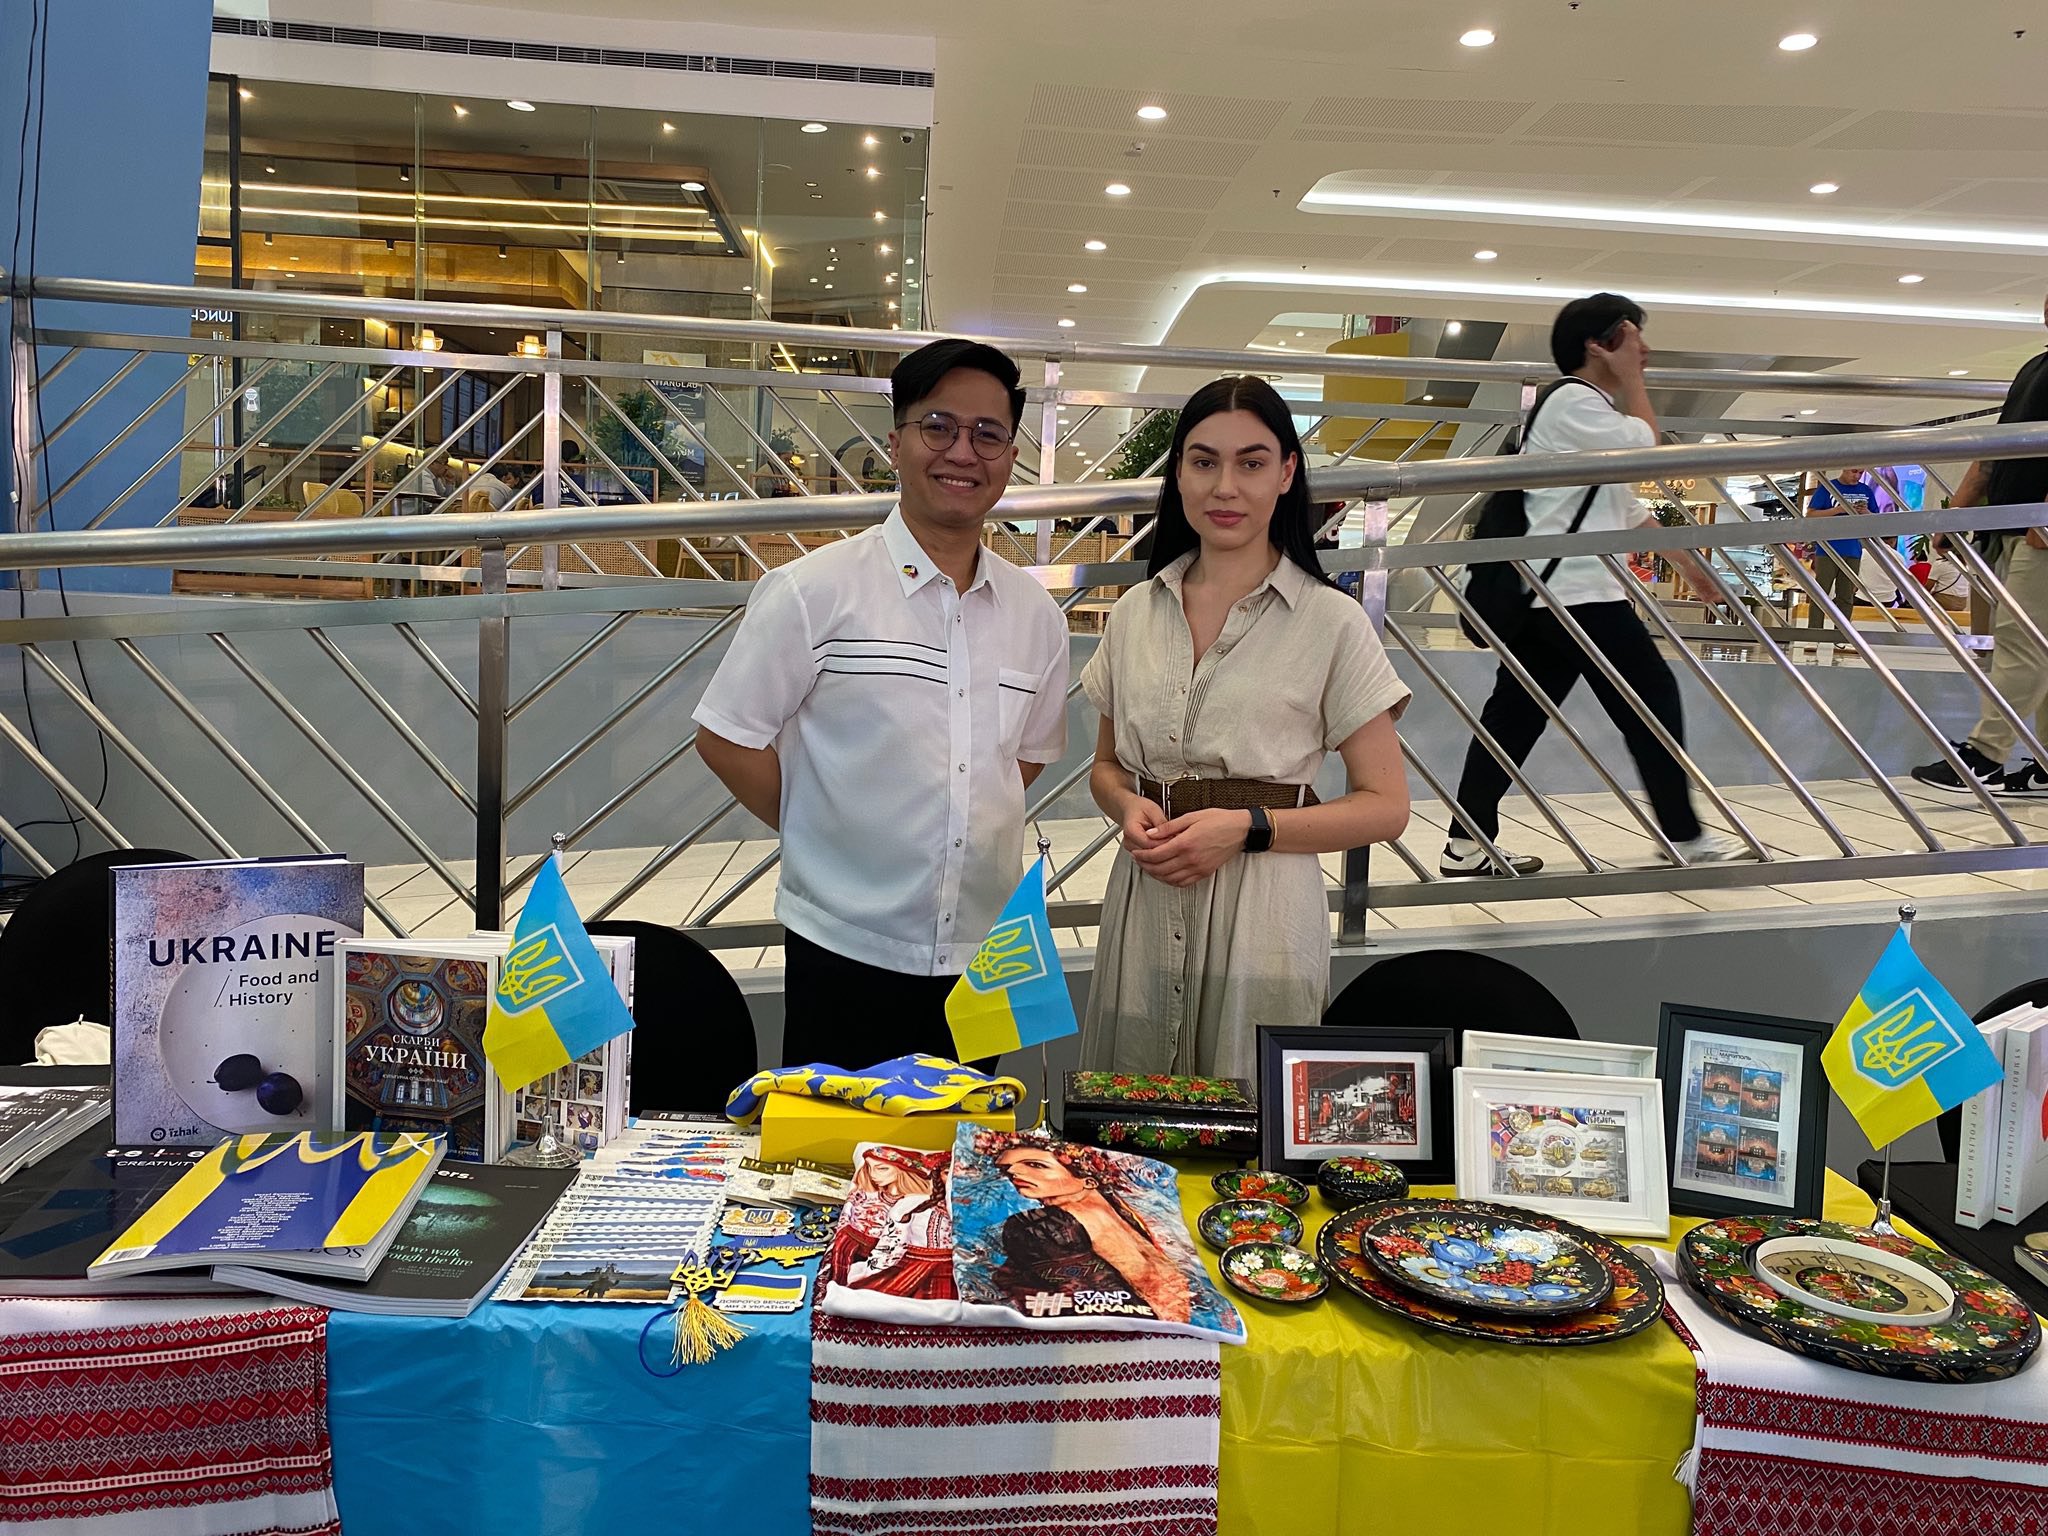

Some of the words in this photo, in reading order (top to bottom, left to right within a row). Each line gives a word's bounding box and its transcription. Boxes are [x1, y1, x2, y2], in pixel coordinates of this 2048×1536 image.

[149, 930, 335, 967] UKRAINE
[239, 972, 282, 987] Food
[287, 970, 319, 984] and
[229, 992, 293, 1007] History
[392, 1034, 440, 1047] СКАРБИ
[364, 1045, 467, 1070] УКРАЇНИ
[1967, 1123, 1977, 1161] POLISH
[2008, 1120, 2017, 1158] POLISH
[1965, 1167, 1975, 1200] SPORT
[2004, 1164, 2012, 1196] SPORT
[410, 1246, 428, 1254] we
[432, 1247, 462, 1257] walk
[426, 1254, 448, 1265] the
[449, 1257, 473, 1267] fire
[1767, 1266, 1791, 1275] 10
[1784, 1257, 1805, 1266] 11
[1854, 1262, 1867, 1271] 1
[1886, 1273, 1904, 1284] 2
[1074, 1290, 1131, 1300] STAND
[1074, 1304, 1154, 1316] UKRAINE
